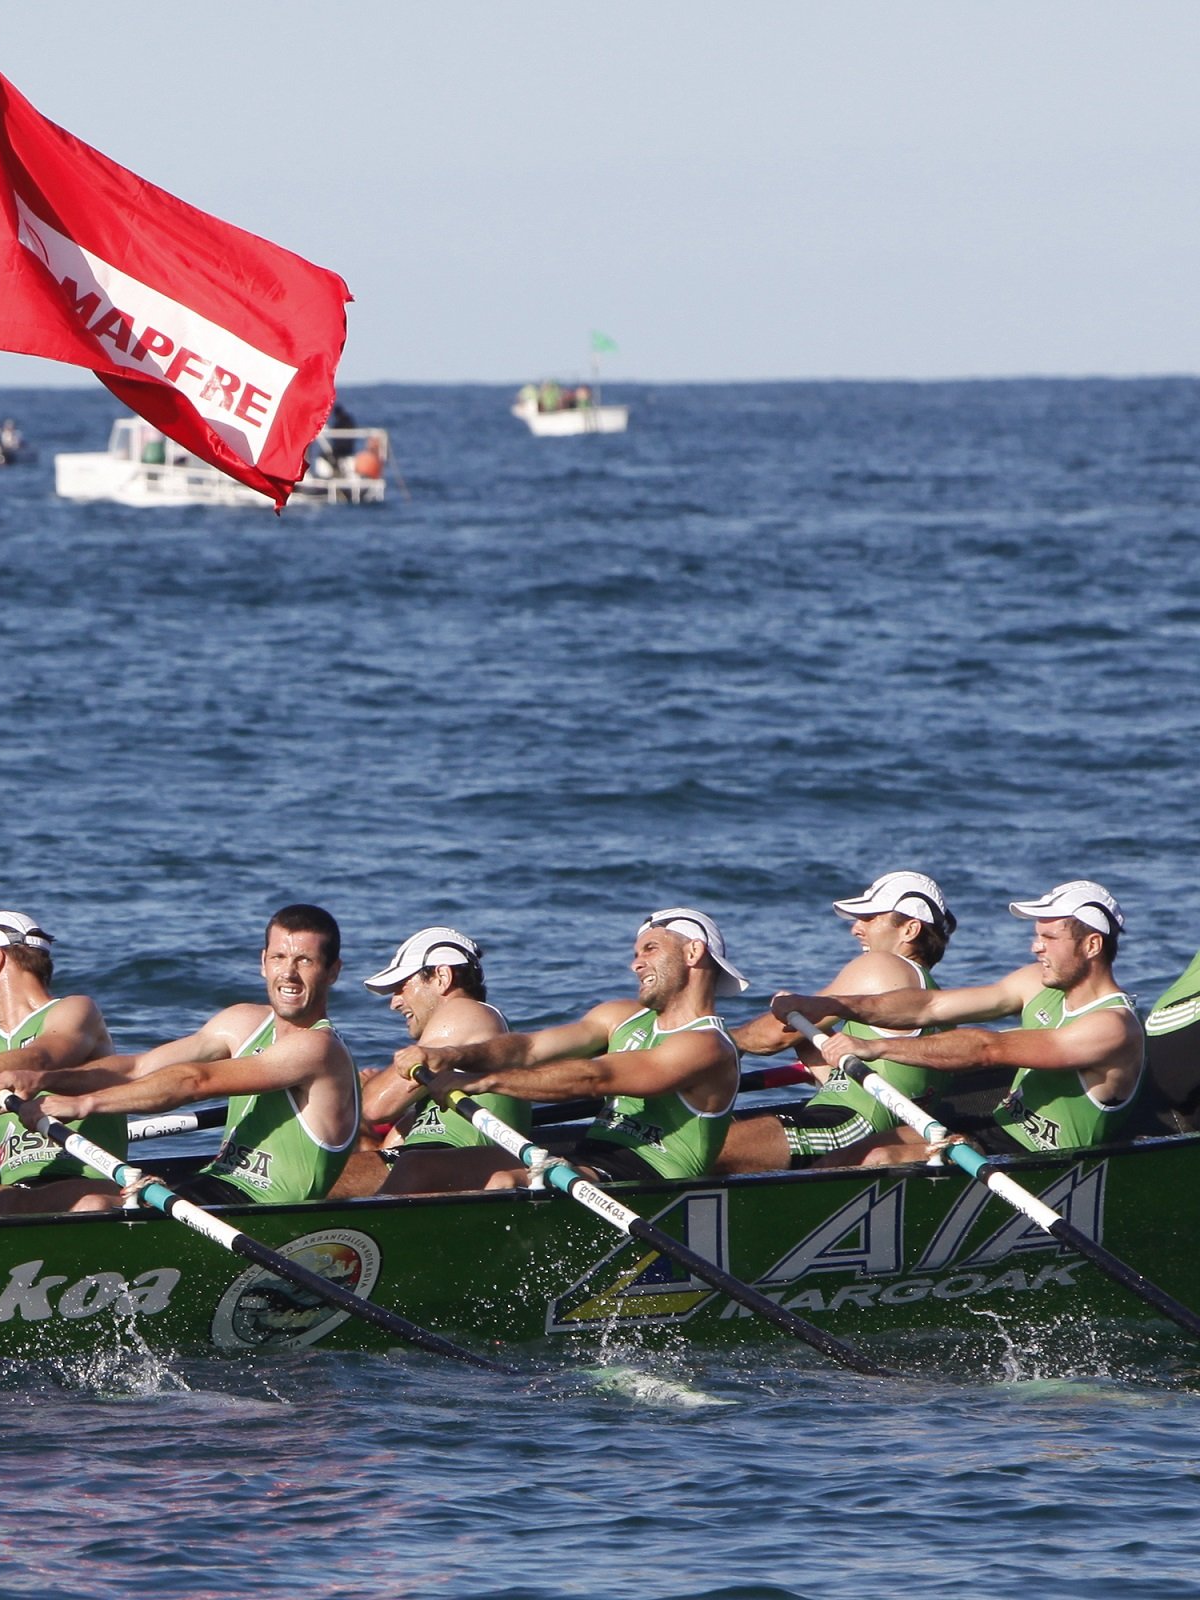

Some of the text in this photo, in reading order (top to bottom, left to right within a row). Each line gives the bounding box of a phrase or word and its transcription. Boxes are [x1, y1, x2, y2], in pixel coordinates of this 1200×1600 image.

[60, 276, 272, 428] MAPFRE
[221, 1141, 273, 1178] RSA
[720, 1261, 1086, 1320] MARGOAK
